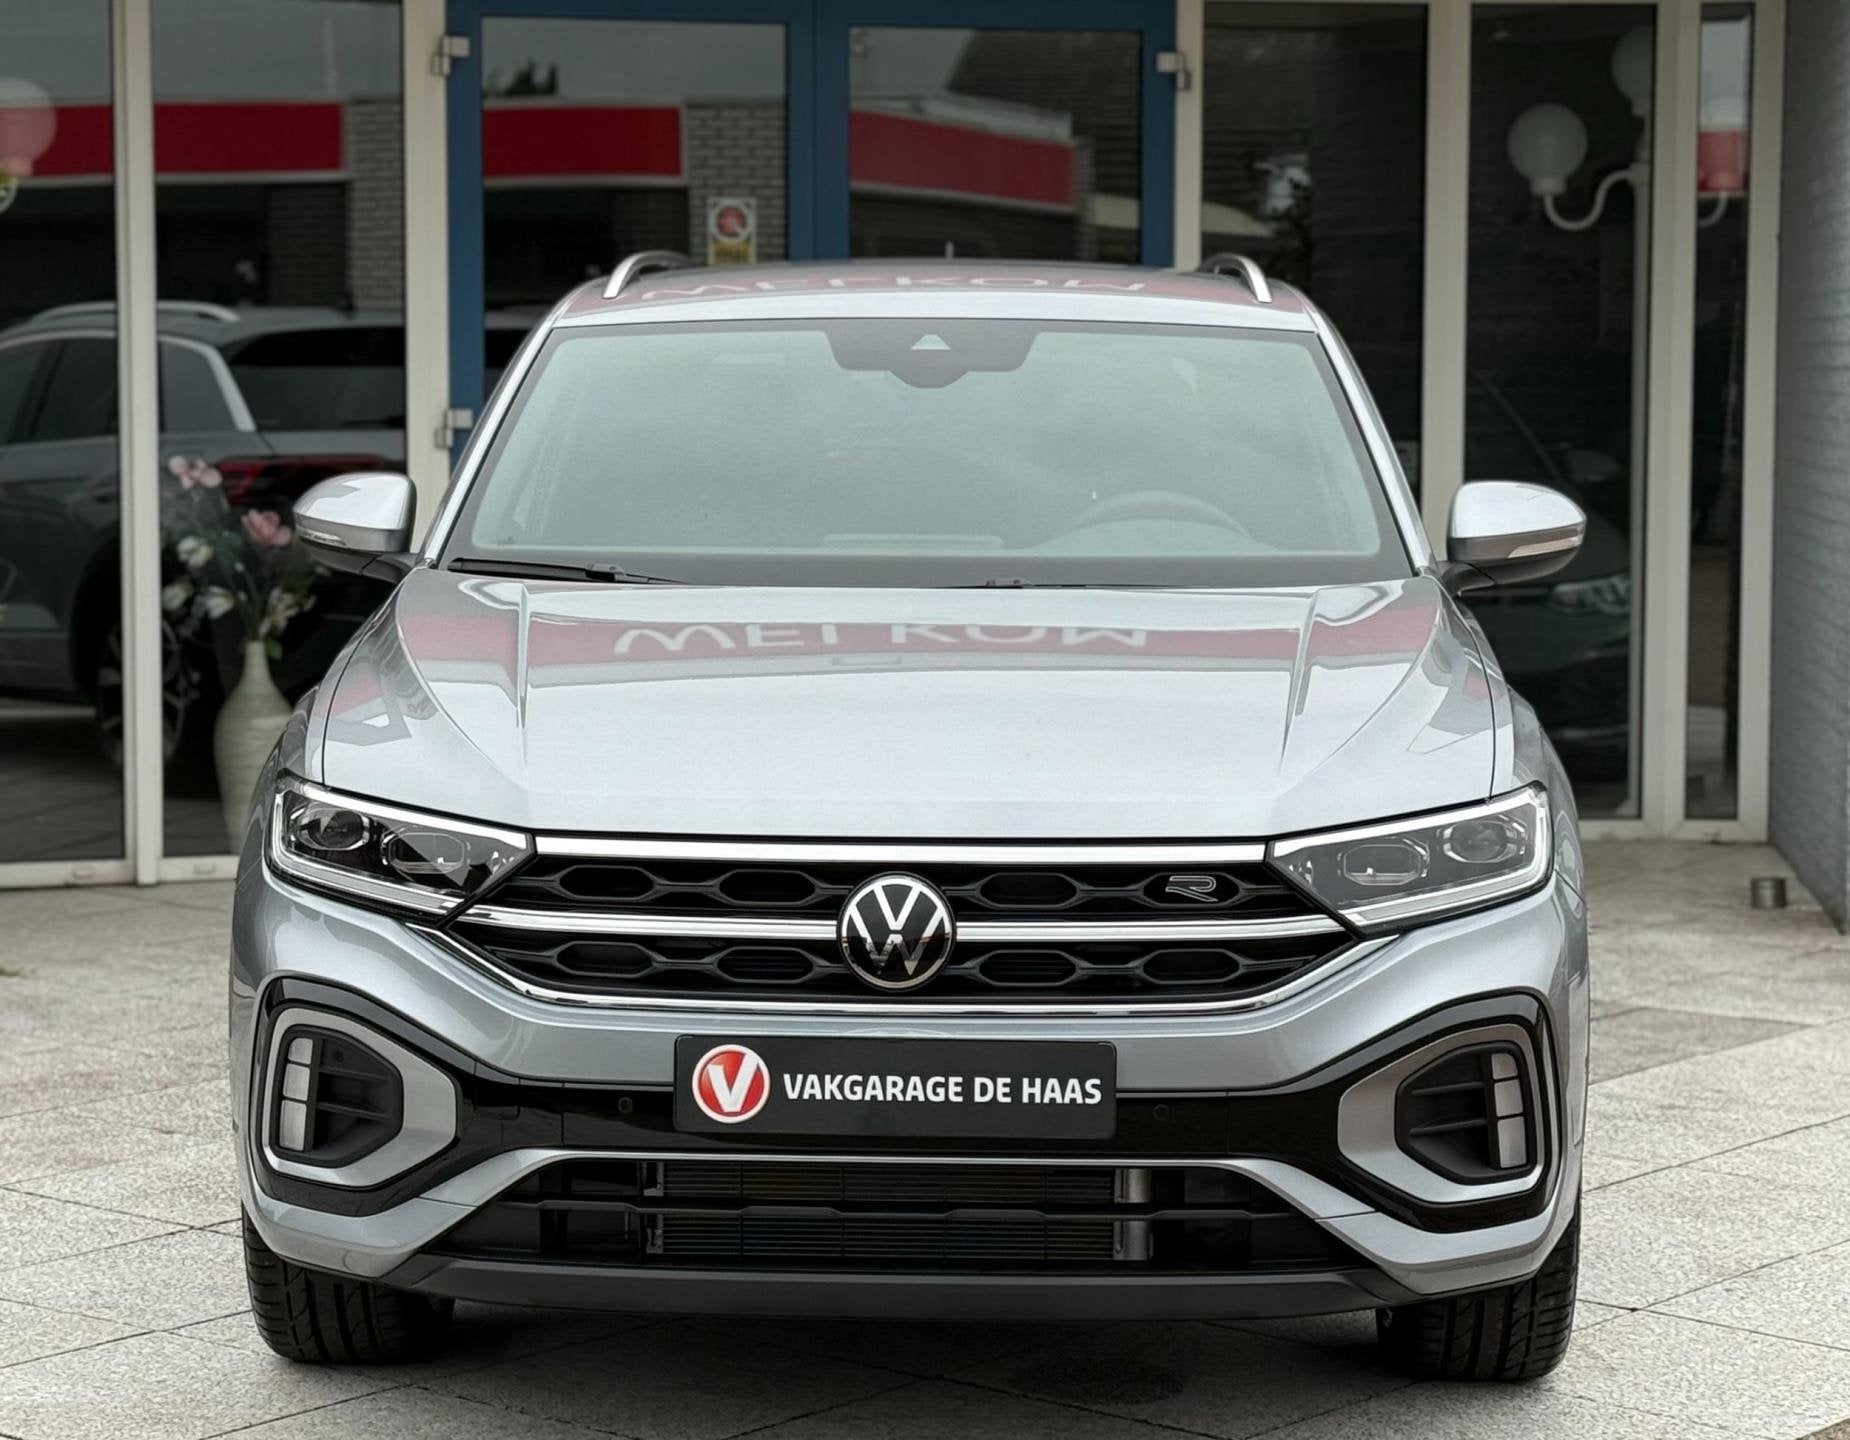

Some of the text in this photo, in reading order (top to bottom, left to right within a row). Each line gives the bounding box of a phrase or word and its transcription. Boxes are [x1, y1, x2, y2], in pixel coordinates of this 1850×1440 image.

[1165, 875, 1219, 903] R
[704, 1052, 761, 1113] V
[783, 1073, 1102, 1105] VAKGARAGE DE HAAS
